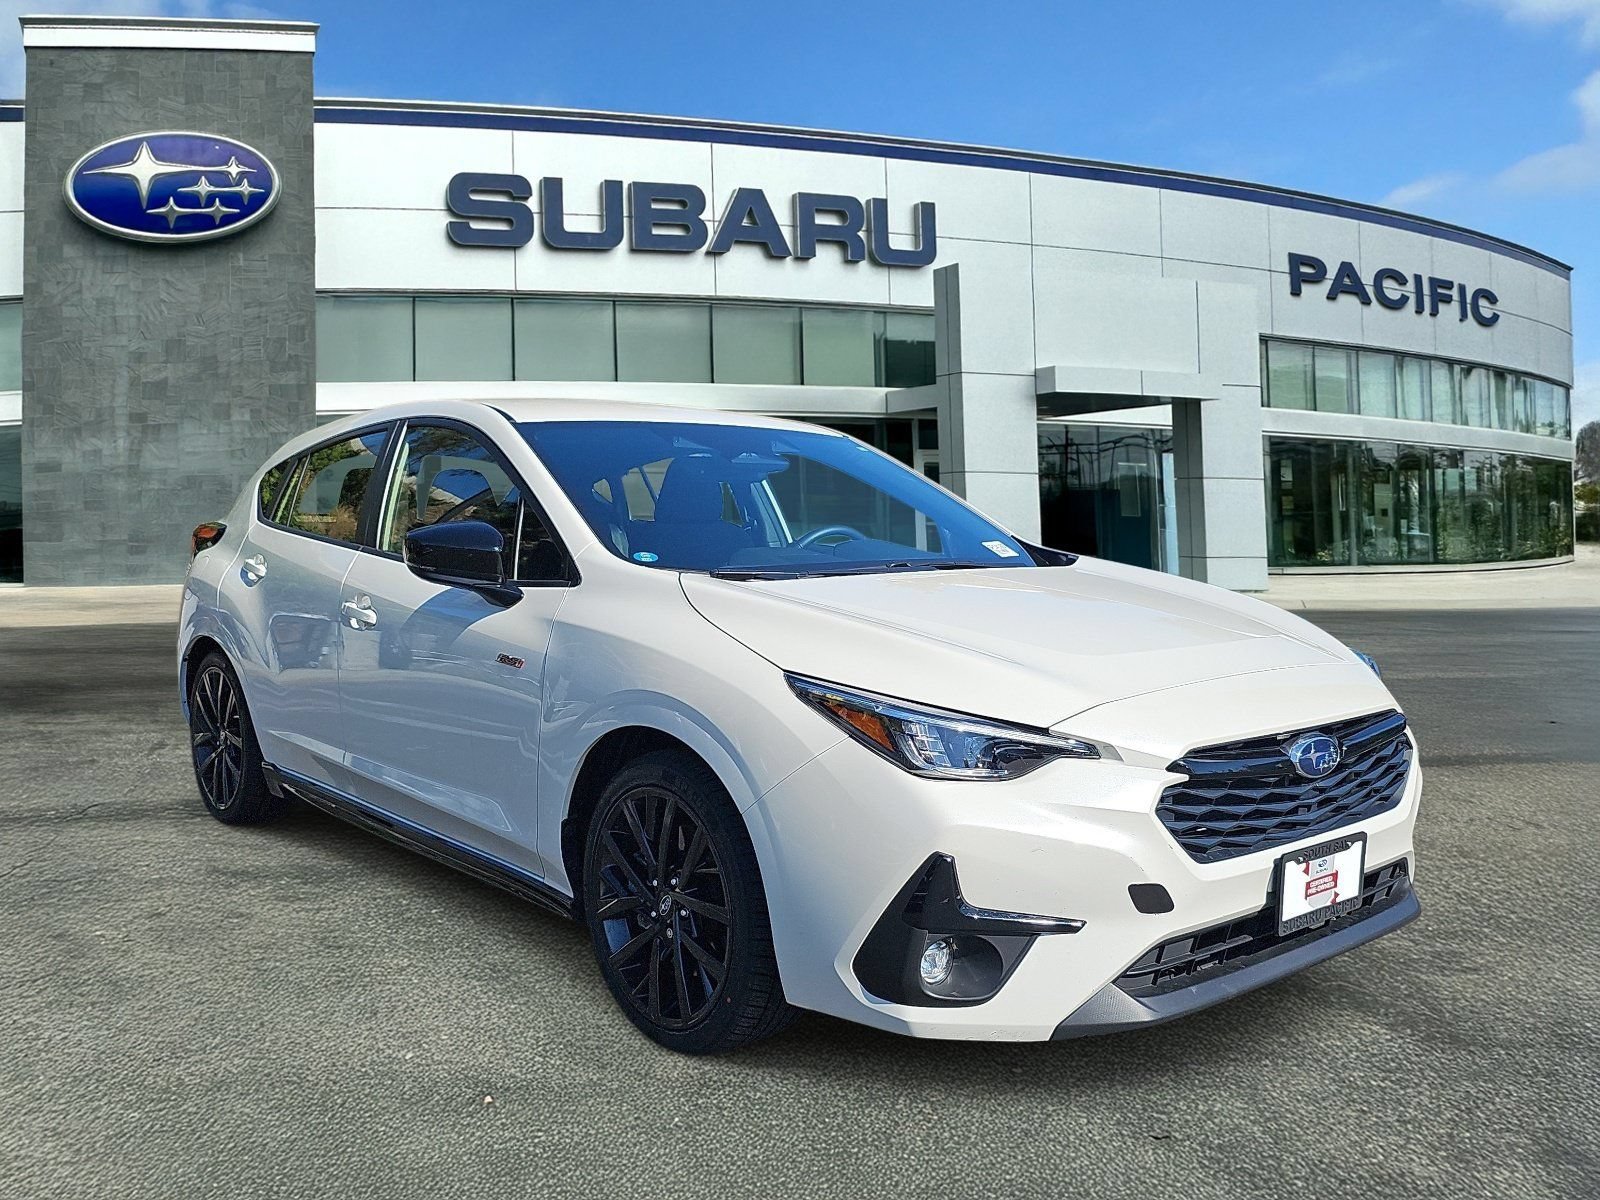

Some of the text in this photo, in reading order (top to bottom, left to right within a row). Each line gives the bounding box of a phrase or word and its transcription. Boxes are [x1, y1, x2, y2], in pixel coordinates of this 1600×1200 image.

[446, 171, 938, 268] SUBARU
[1288, 252, 1500, 327] PACIFIC
[1303, 843, 1332, 860] SOUTH
[1282, 897, 1361, 933] SUBARU PACIFIC
